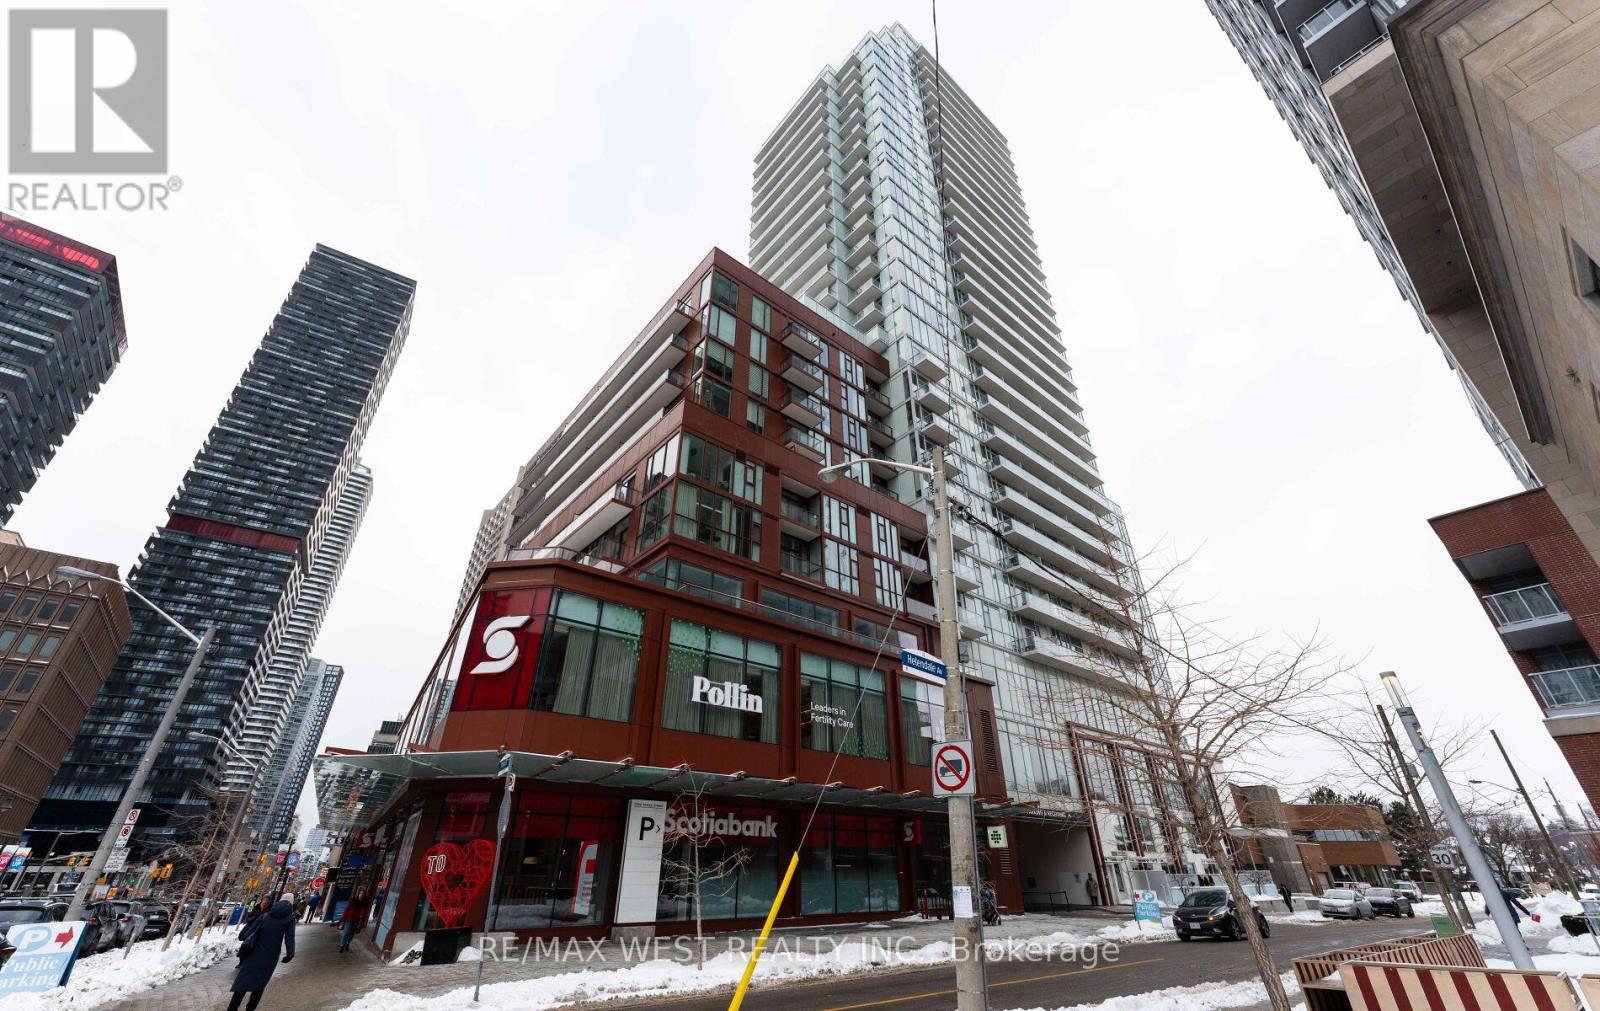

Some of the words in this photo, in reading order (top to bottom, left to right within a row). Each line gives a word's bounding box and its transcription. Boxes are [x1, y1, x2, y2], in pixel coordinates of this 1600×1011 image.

[907, 654, 936, 672] Helendale
[691, 675, 763, 714] Pollin
[810, 701, 838, 715] Leaders
[839, 706, 846, 716] in
[810, 712, 836, 727] Fertility
[837, 717, 854, 729] Care
[639, 816, 655, 841] P
[664, 807, 779, 838] Scotiabank
[1431, 853, 1451, 865] 30
[5, 956, 59, 973] Public
[0, 972, 59, 988] arking
